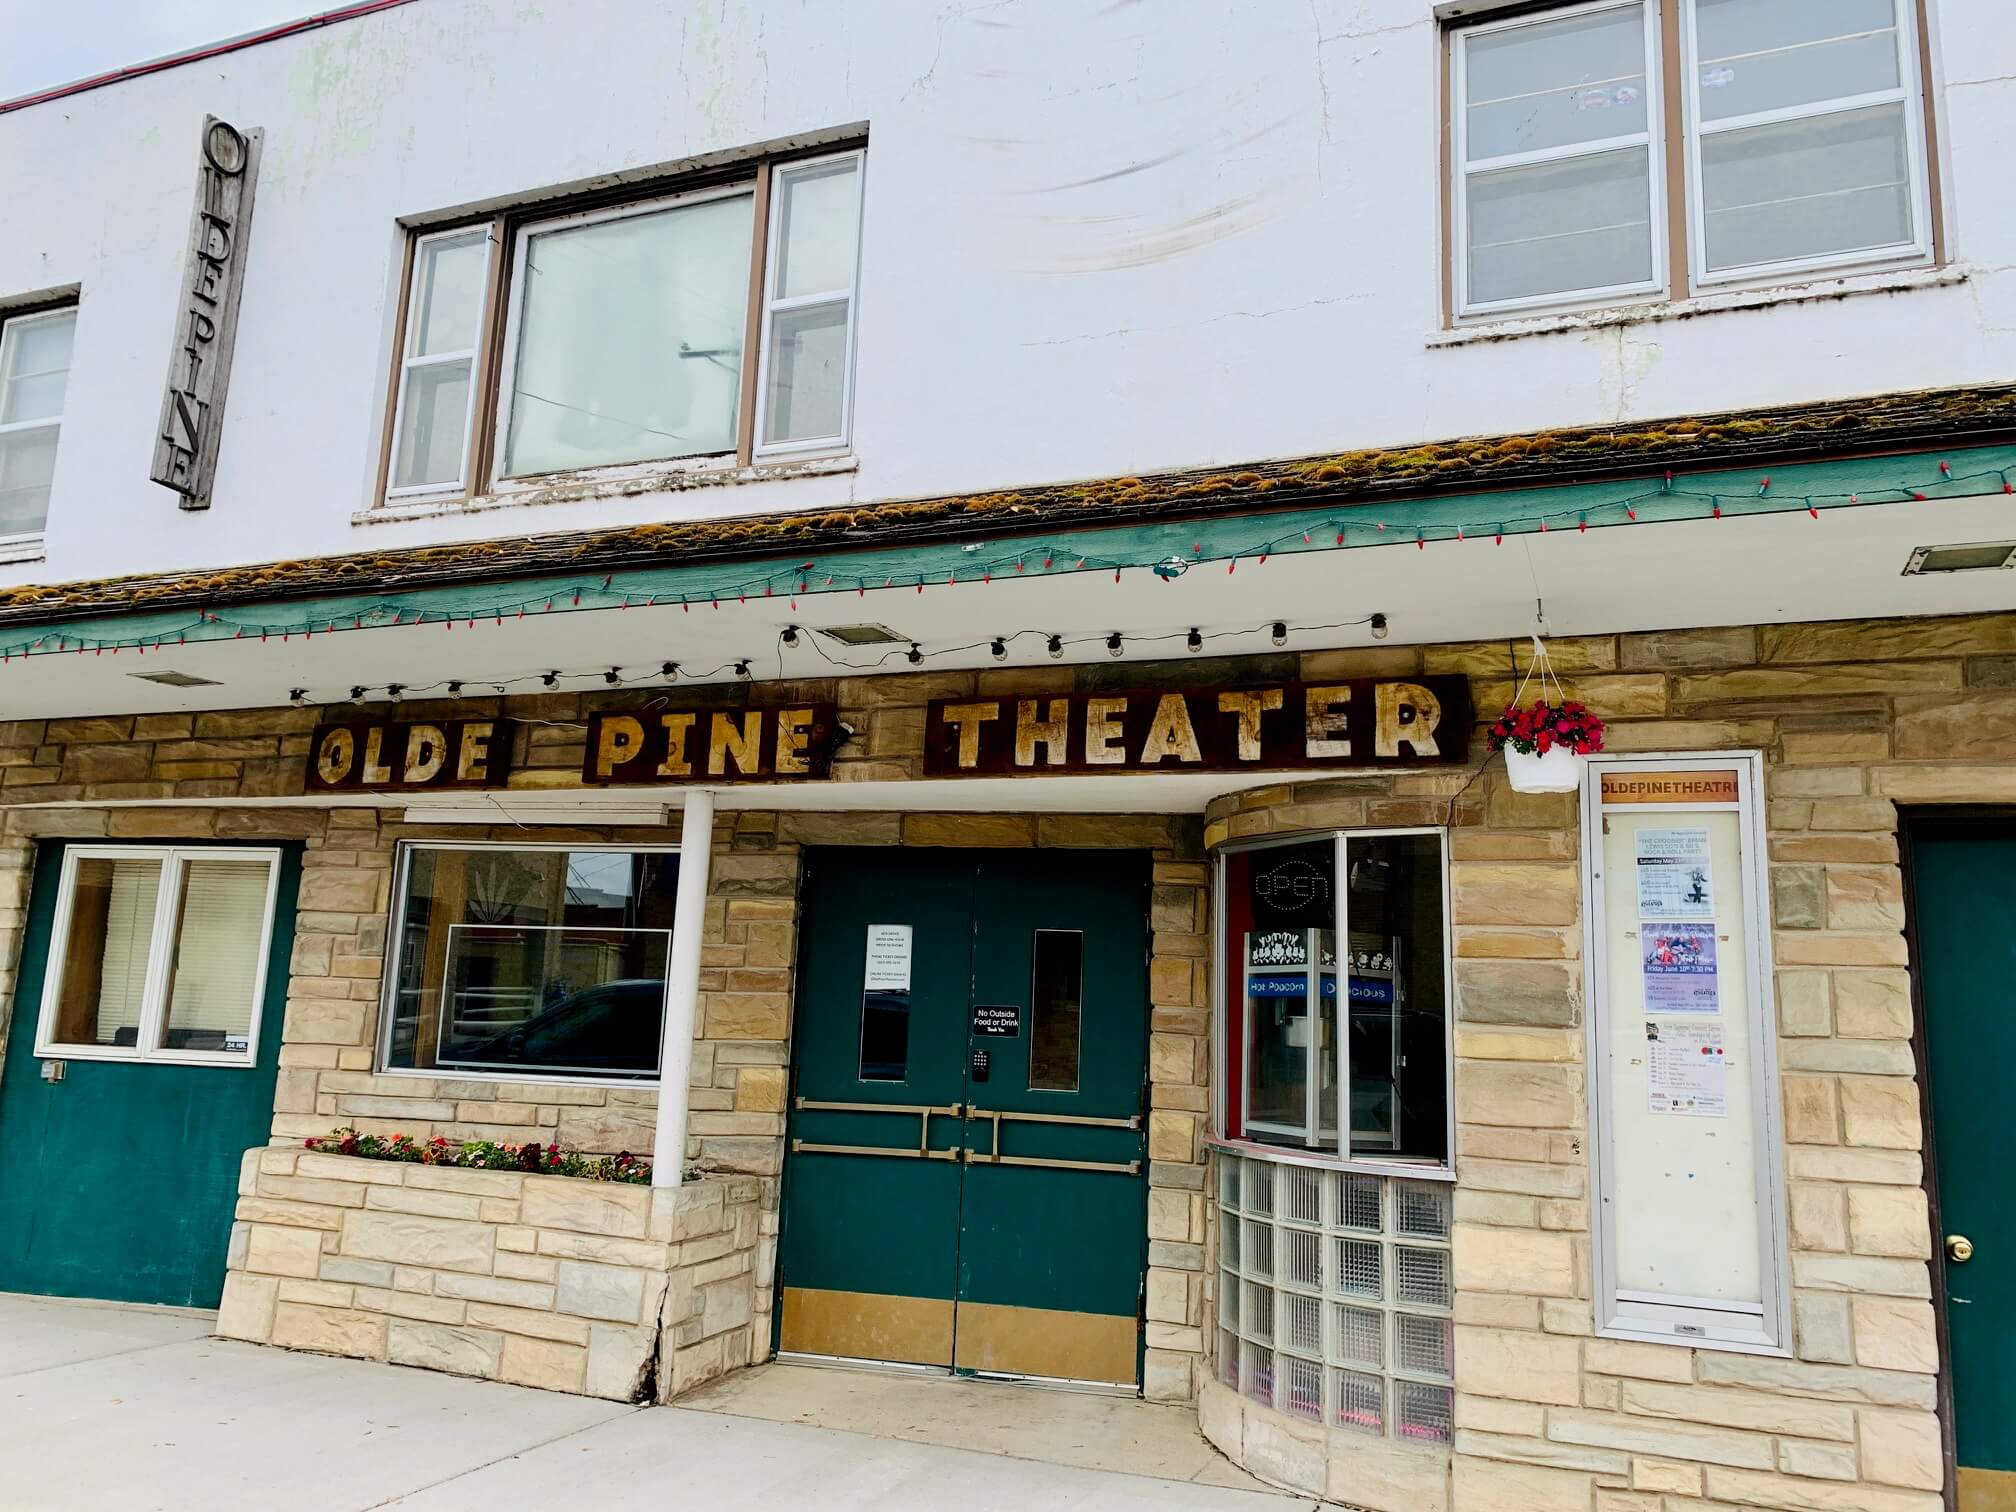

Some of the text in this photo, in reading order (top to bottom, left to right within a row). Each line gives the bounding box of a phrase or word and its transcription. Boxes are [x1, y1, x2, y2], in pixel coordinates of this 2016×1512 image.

[162, 121, 248, 495] OLDE PINE
[317, 682, 1442, 784] OLDE PINE THEATER
[1647, 965, 1663, 973] Friday
[977, 1009, 1016, 1018] No Outside
[974, 1018, 992, 1026] Food
[1001, 1018, 1019, 1027] Drink
